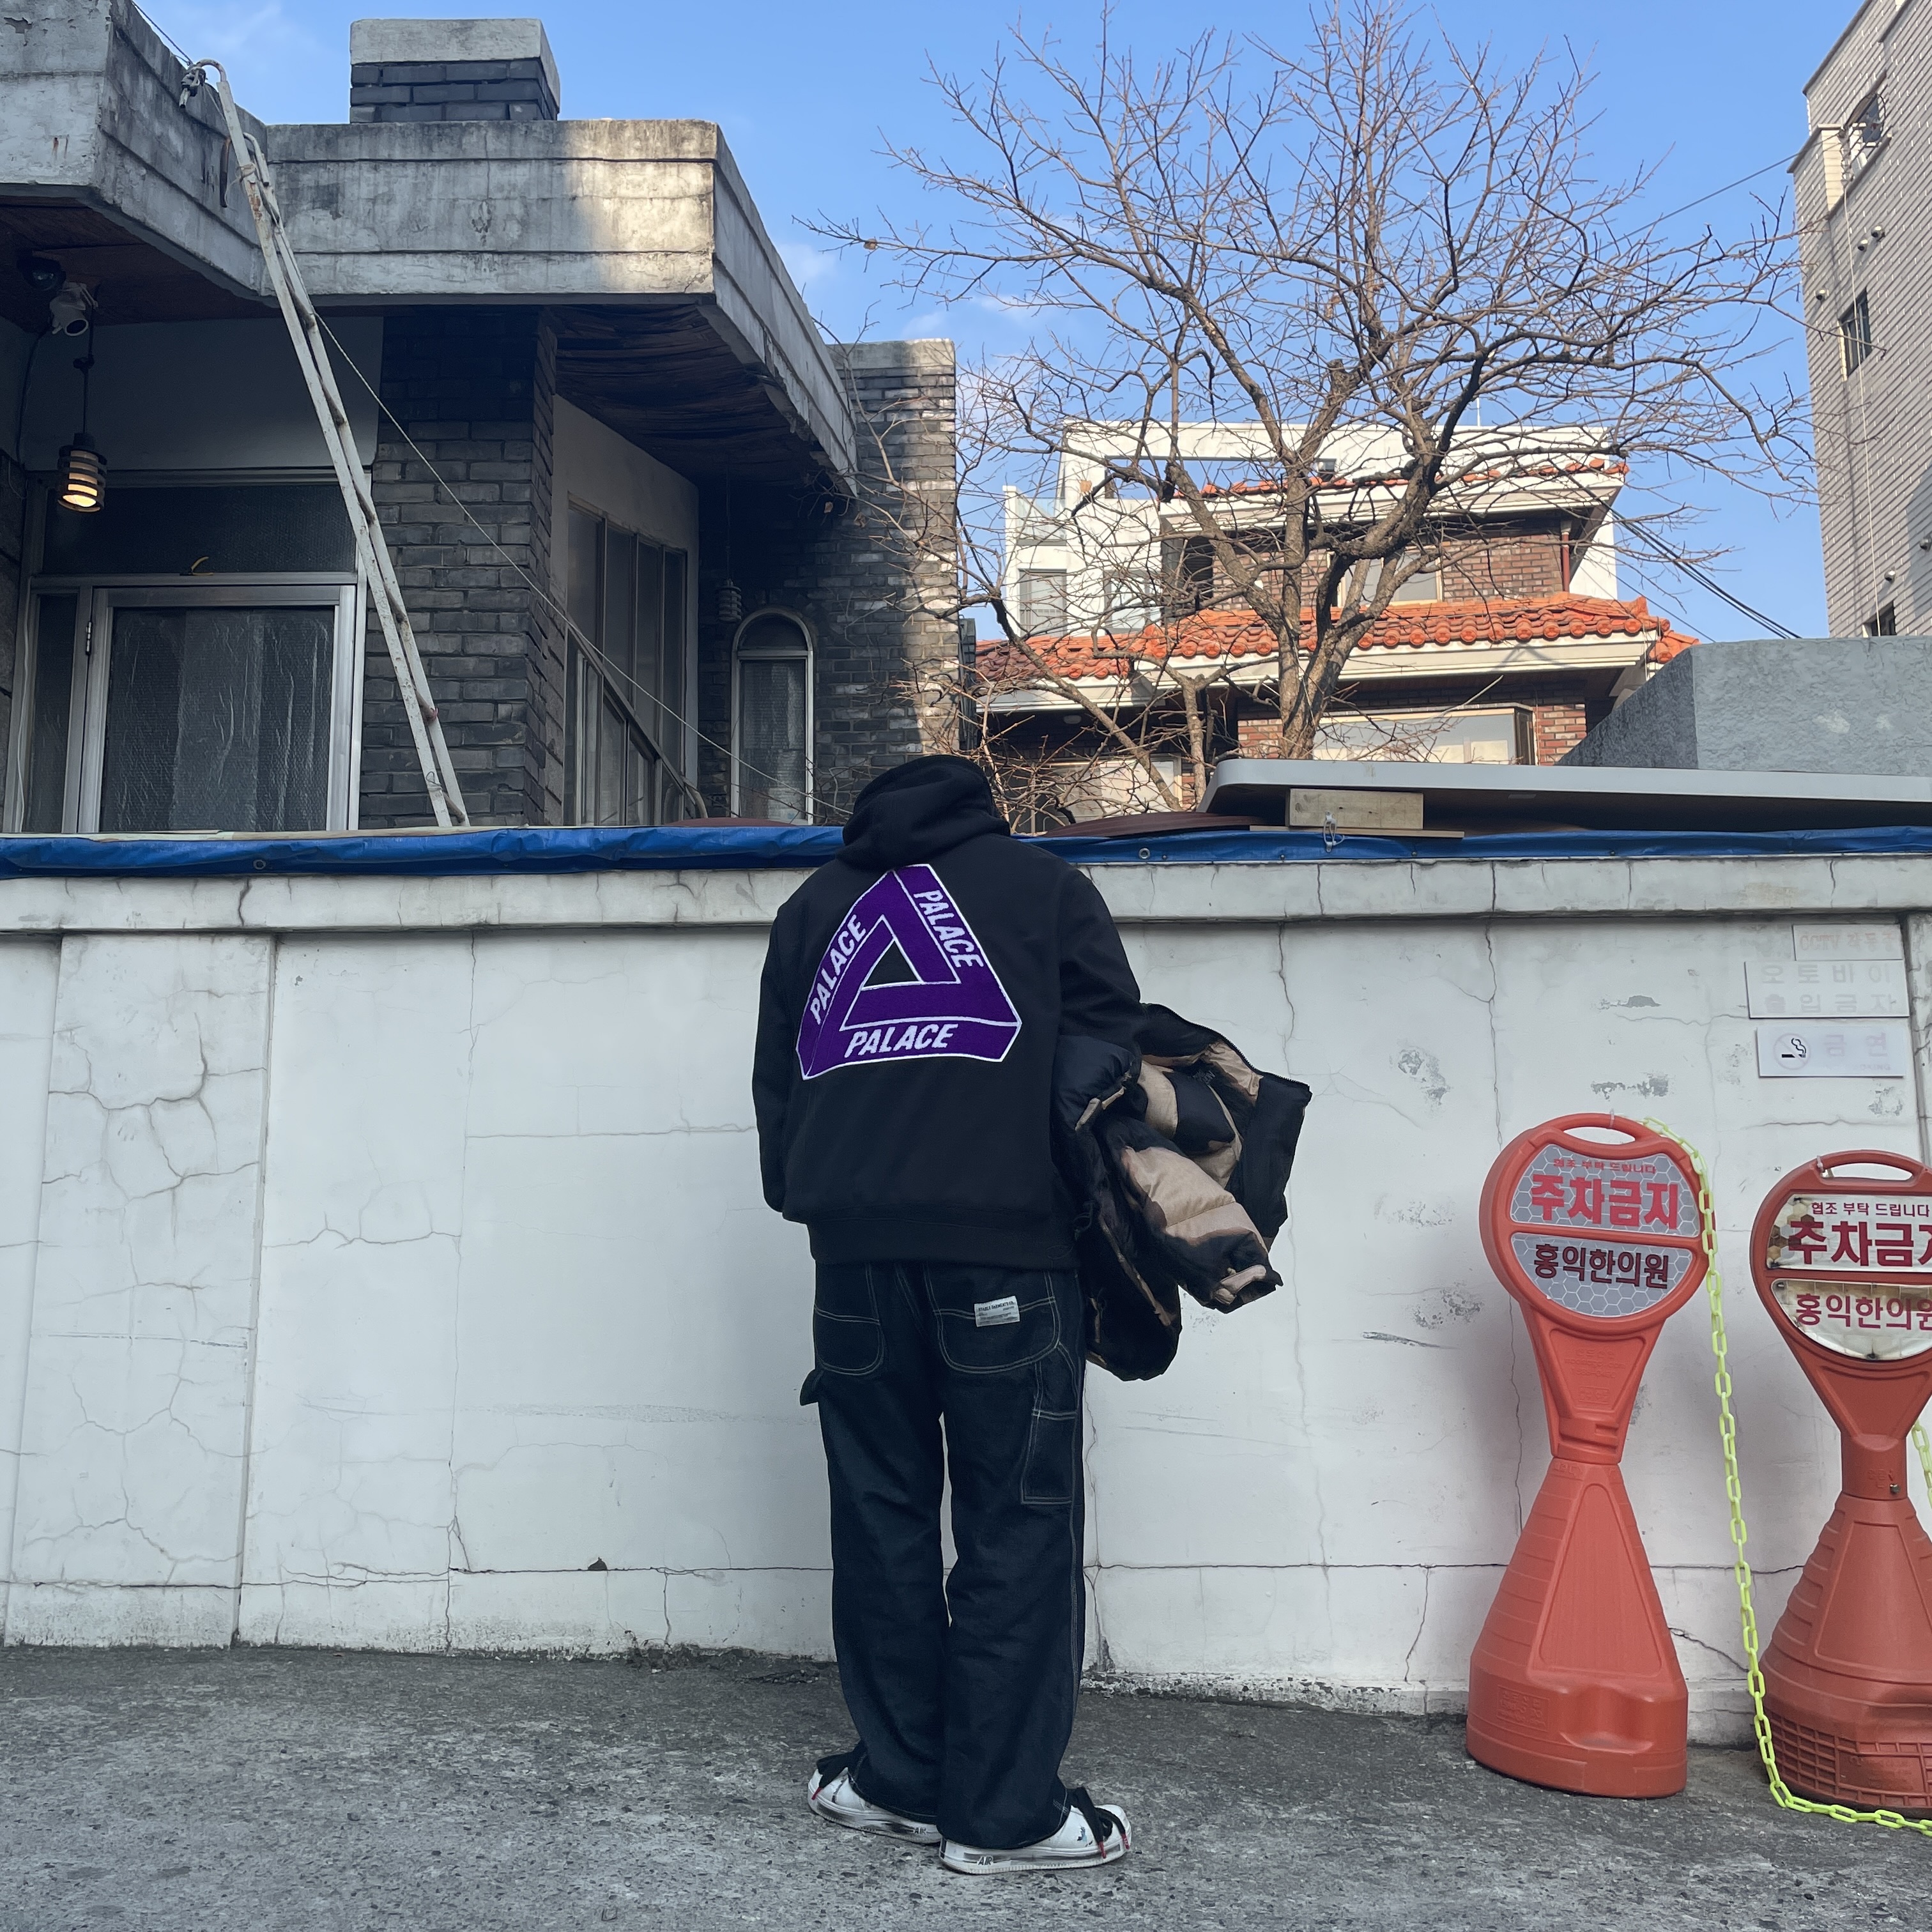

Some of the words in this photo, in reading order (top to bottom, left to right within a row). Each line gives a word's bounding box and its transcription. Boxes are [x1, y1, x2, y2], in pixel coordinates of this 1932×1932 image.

[914, 889, 984, 968] PALACE
[809, 914, 866, 1025] PALACE
[844, 1023, 958, 1058] PALACE
[1531, 1174, 1678, 1230] 주차금지
[1811, 1202, 1838, 1215] 협조
[1843, 1202, 1869, 1216] 부탁
[1875, 1203, 1930, 1218] 드립니다
[1534, 1243, 1669, 1289] 홍익한의원
[978, 1856, 993, 1865] AIR
